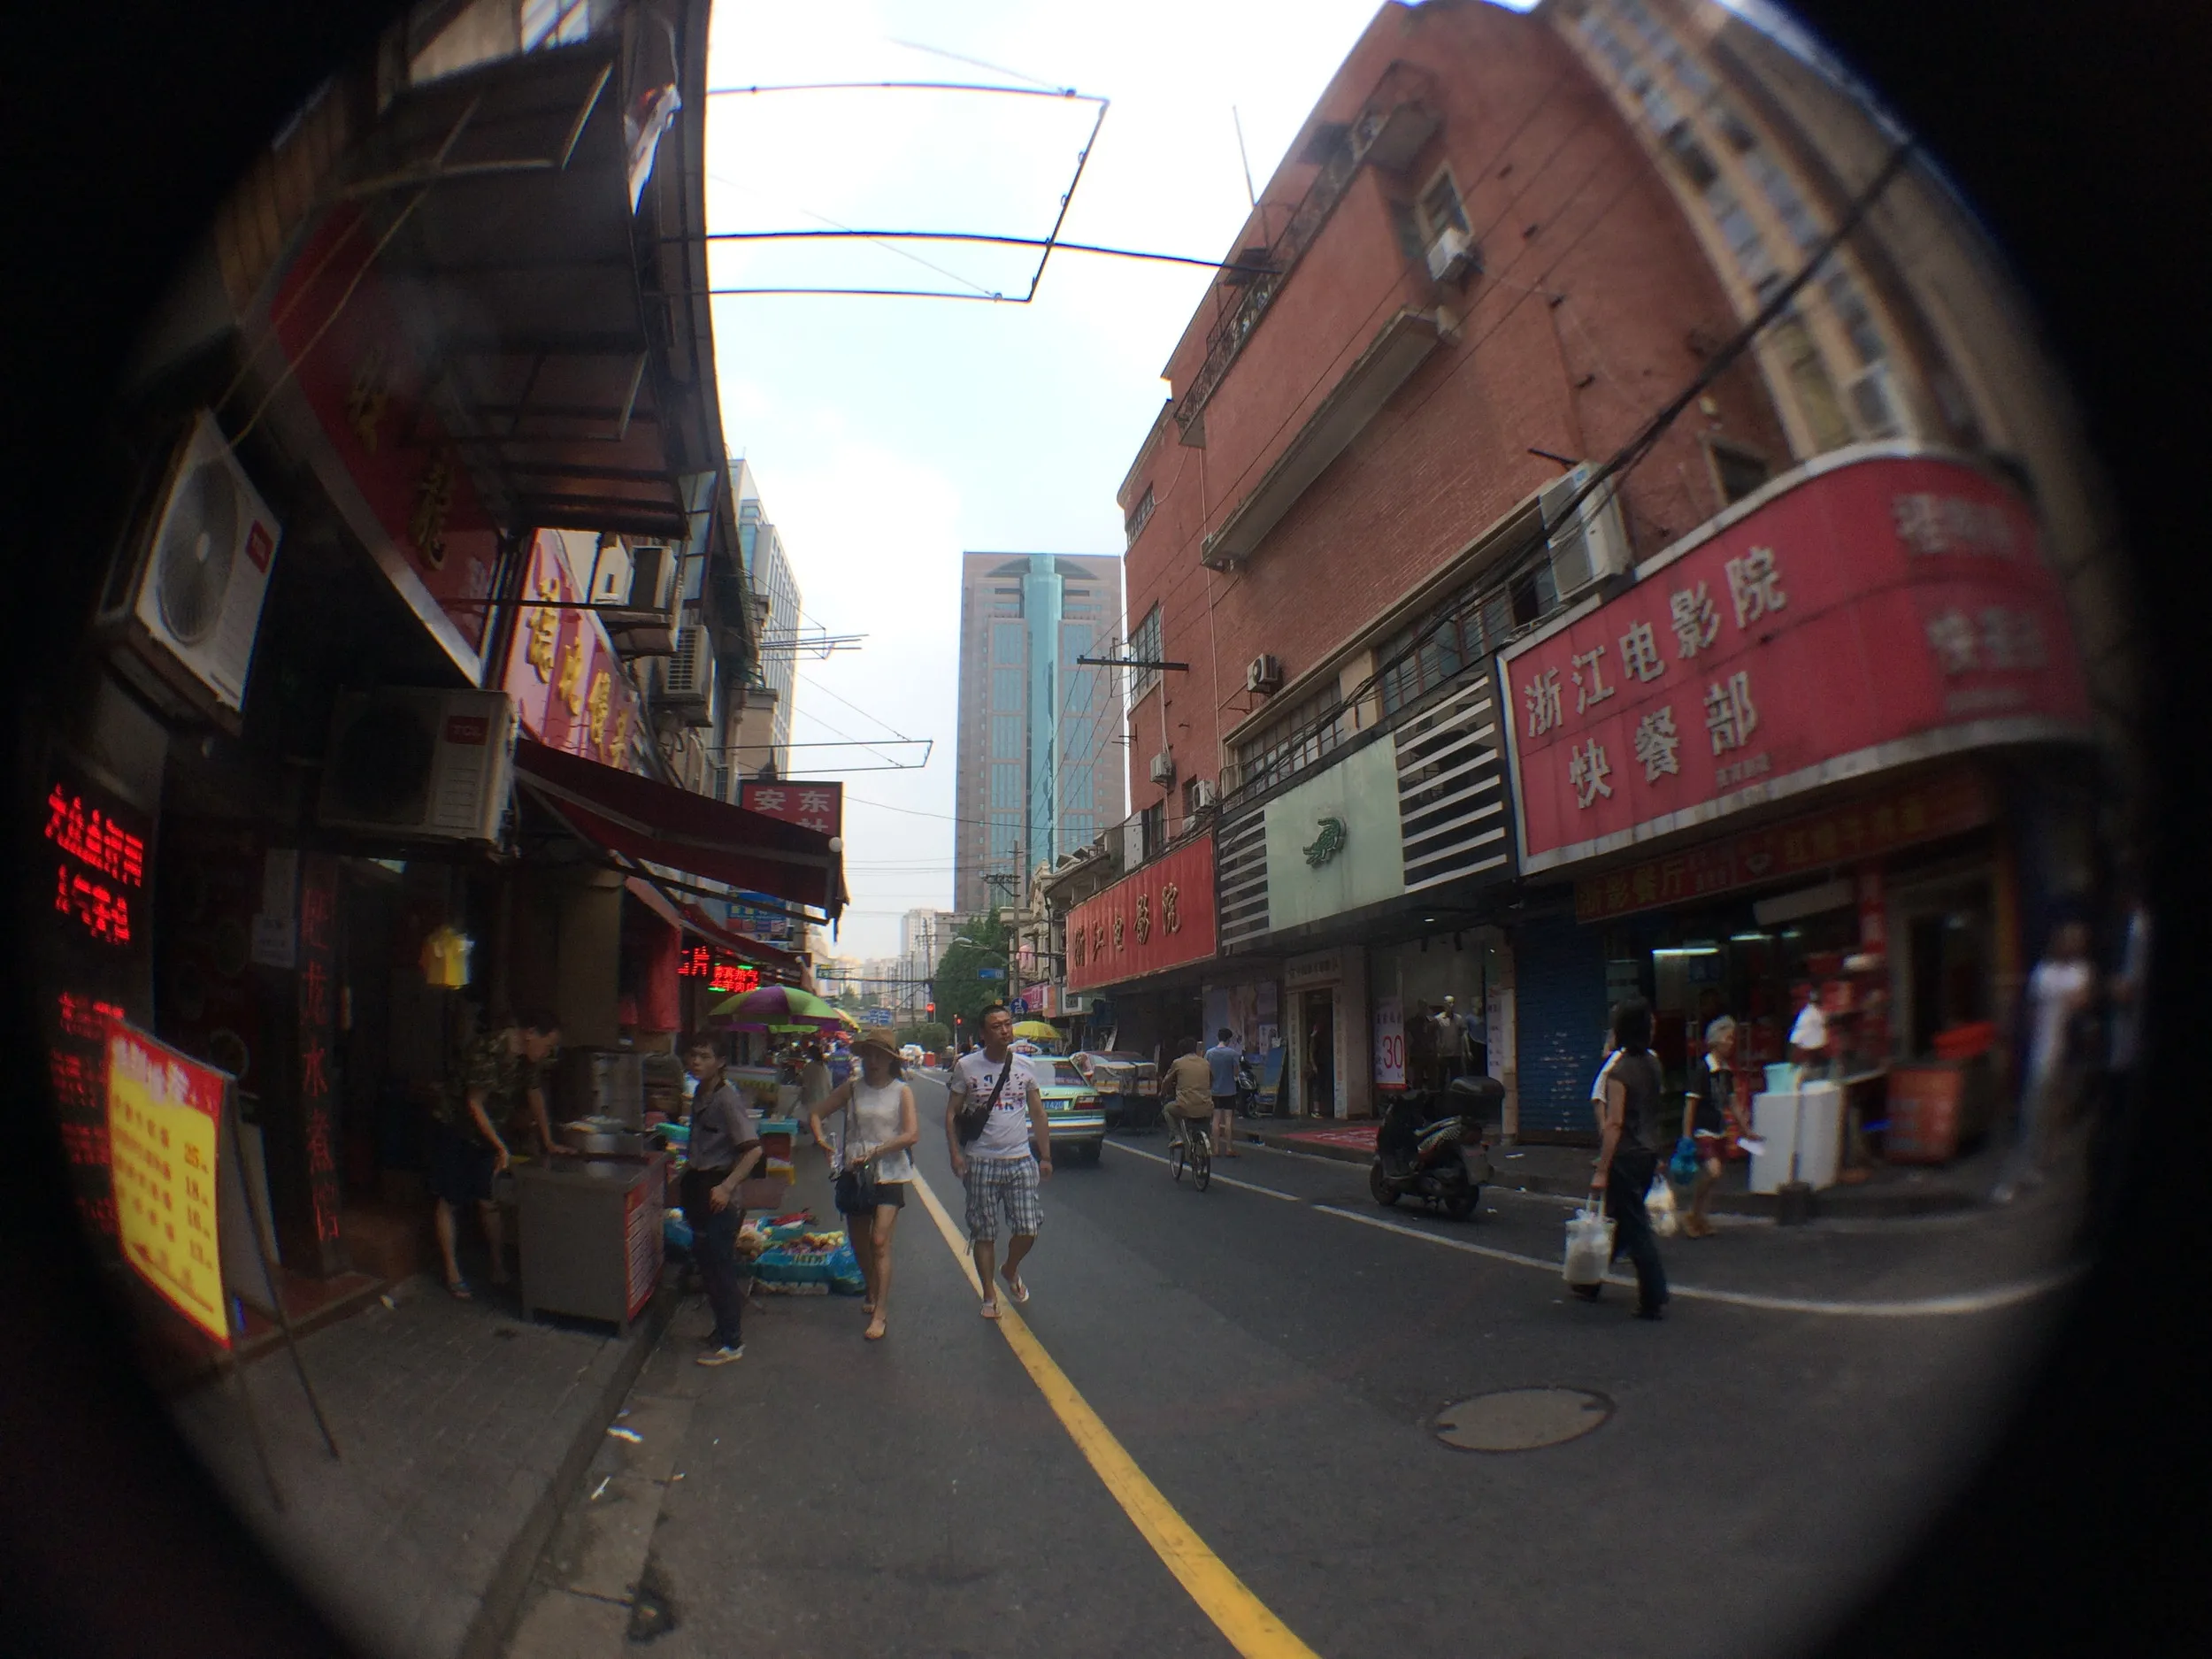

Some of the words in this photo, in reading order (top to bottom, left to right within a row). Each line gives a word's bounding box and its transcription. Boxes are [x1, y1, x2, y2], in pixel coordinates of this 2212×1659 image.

[1524, 545, 1788, 738] 浙江电影院
[1568, 671, 1760, 809] 快餐部
[754, 788, 830, 813] 安东
[1074, 882, 1181, 967] 浙江电影院
[1382, 1034, 1403, 1070] 30
